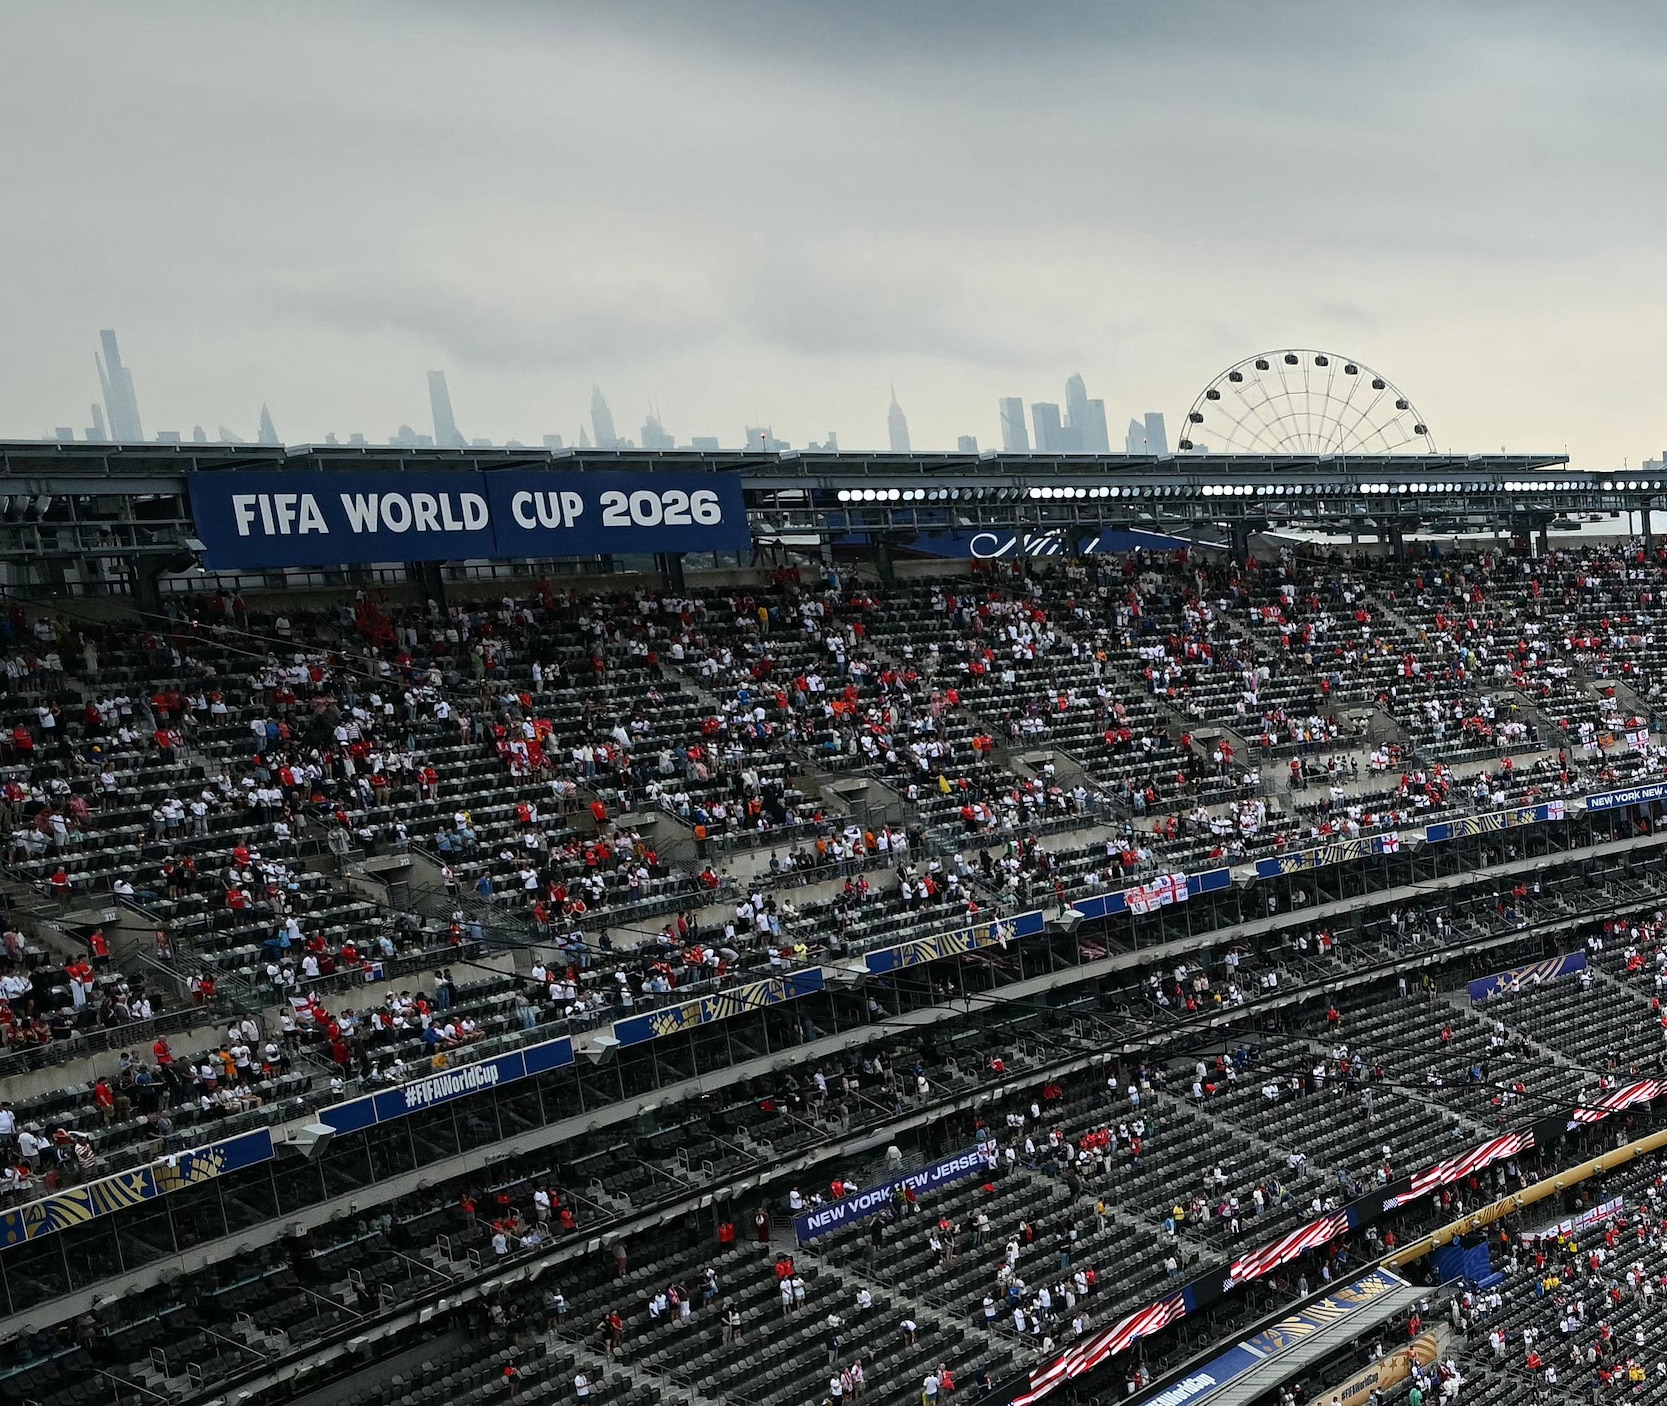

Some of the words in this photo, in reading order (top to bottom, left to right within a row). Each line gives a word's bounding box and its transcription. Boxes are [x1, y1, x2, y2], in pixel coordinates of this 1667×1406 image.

[232, 493, 329, 536] FIFA
[340, 492, 489, 534] WORLD
[511, 490, 583, 529] CUP
[600, 490, 722, 527] 2026
[1591, 794, 1613, 807] NEW
[1615, 790, 1641, 803] YORK
[1642, 787, 1663, 798] NEW
[405, 1064, 499, 1107] #FIFAWorldCup
[807, 1205, 846, 1235] NEW
[848, 1187, 891, 1218] YORK
[1340, 1372, 1379, 1402] #FIFAWorldCup
